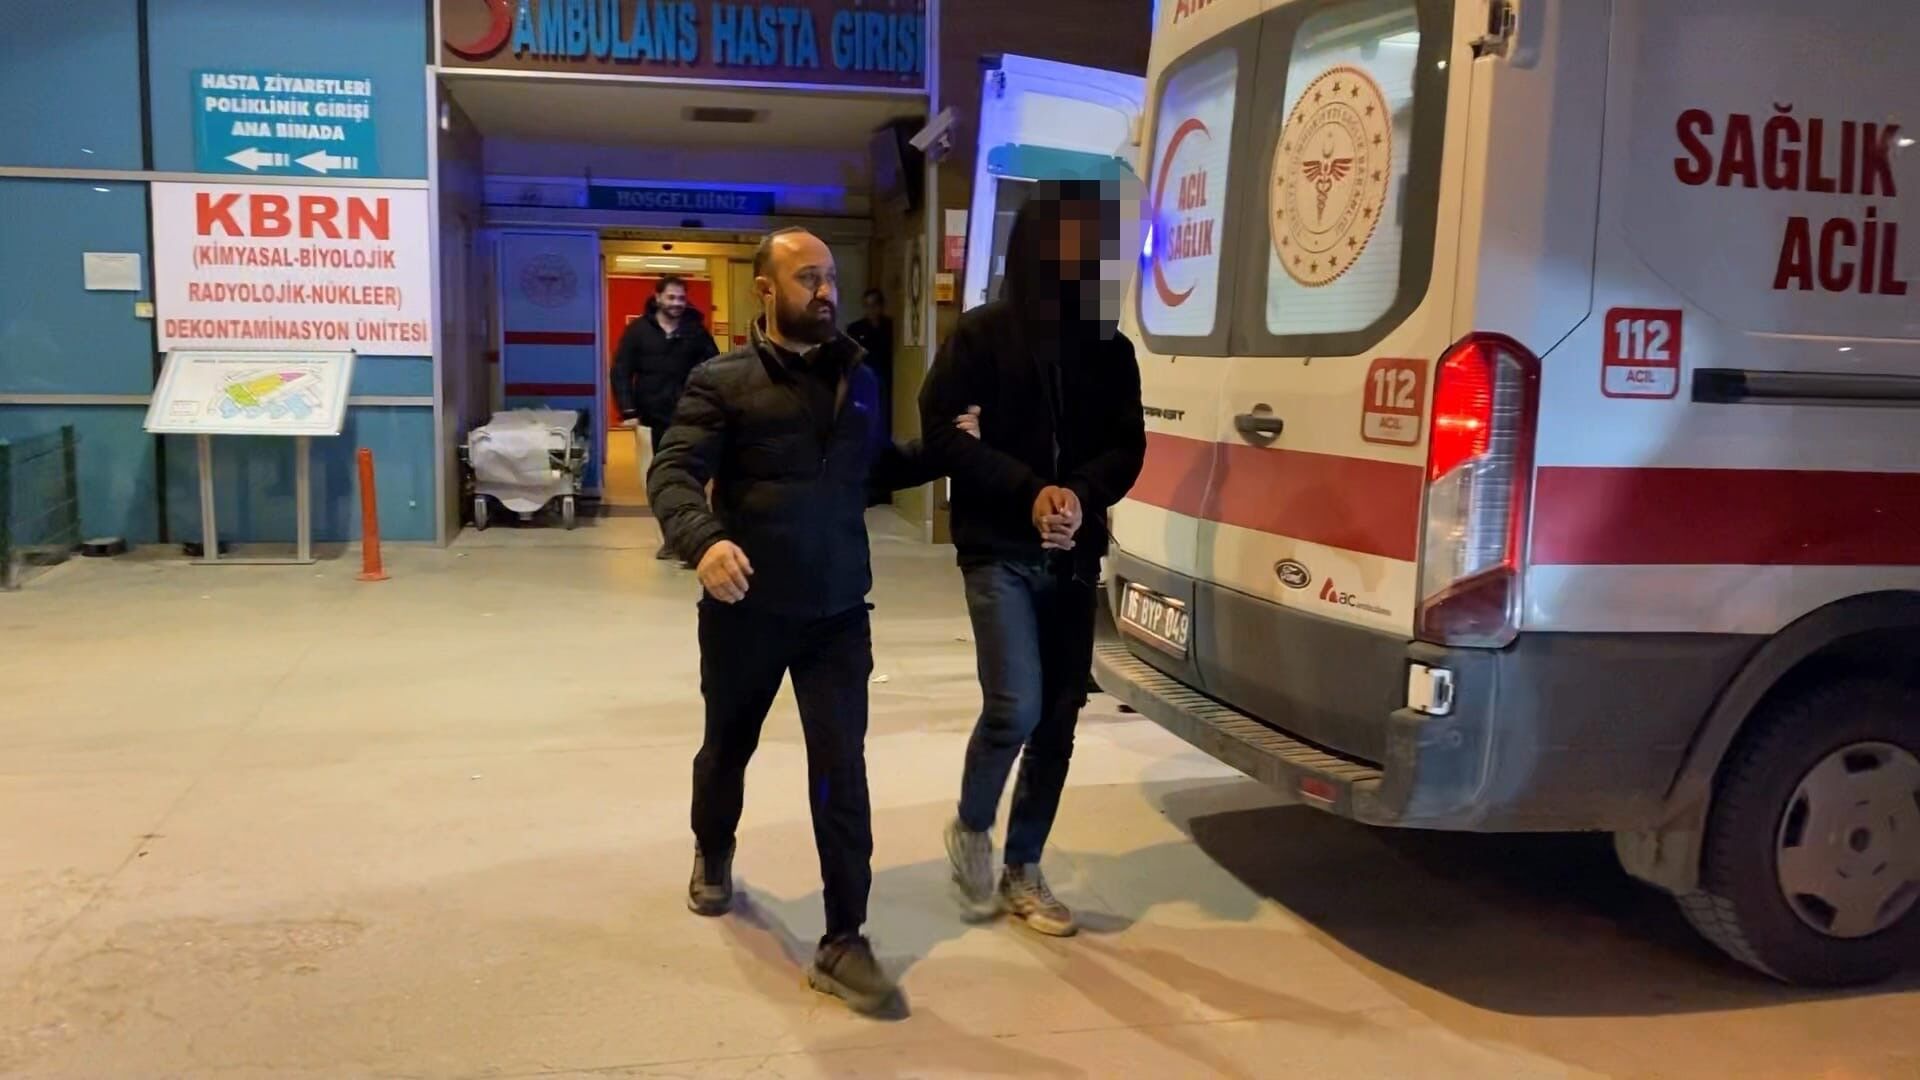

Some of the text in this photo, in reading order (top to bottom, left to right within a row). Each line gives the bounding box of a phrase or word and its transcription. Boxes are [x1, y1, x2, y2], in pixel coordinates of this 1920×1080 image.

[512, 0, 697, 63] AMBULANS
[711, 4, 820, 68] HASTA
[202, 73, 371, 96] HASTA ZİYARETLERİ
[205, 94, 369, 122] POLİKLİNİK GİRİŞİ
[231, 119, 345, 141] ANA BİNADA
[1673, 102, 1900, 198] SAĞLIK
[1178, 166, 1207, 212] ACİL
[195, 193, 390, 241] KBRN
[193, 242, 396, 270] (KİMYASAL-BİYOLOJİK
[1167, 217, 1214, 261] SAĞLIK
[1773, 205, 1908, 296] ACİL
[188, 280, 403, 311] RADYOLOJİK-NÜKLEER)
[164, 316, 428, 343] DEKONTAMİNASYON ÜNİTESİ
[1615, 318, 1671, 360] 112
[1374, 368, 1417, 409] 112
[1141, 595, 1163, 631] BYP
[1164, 607, 1190, 645] 049
